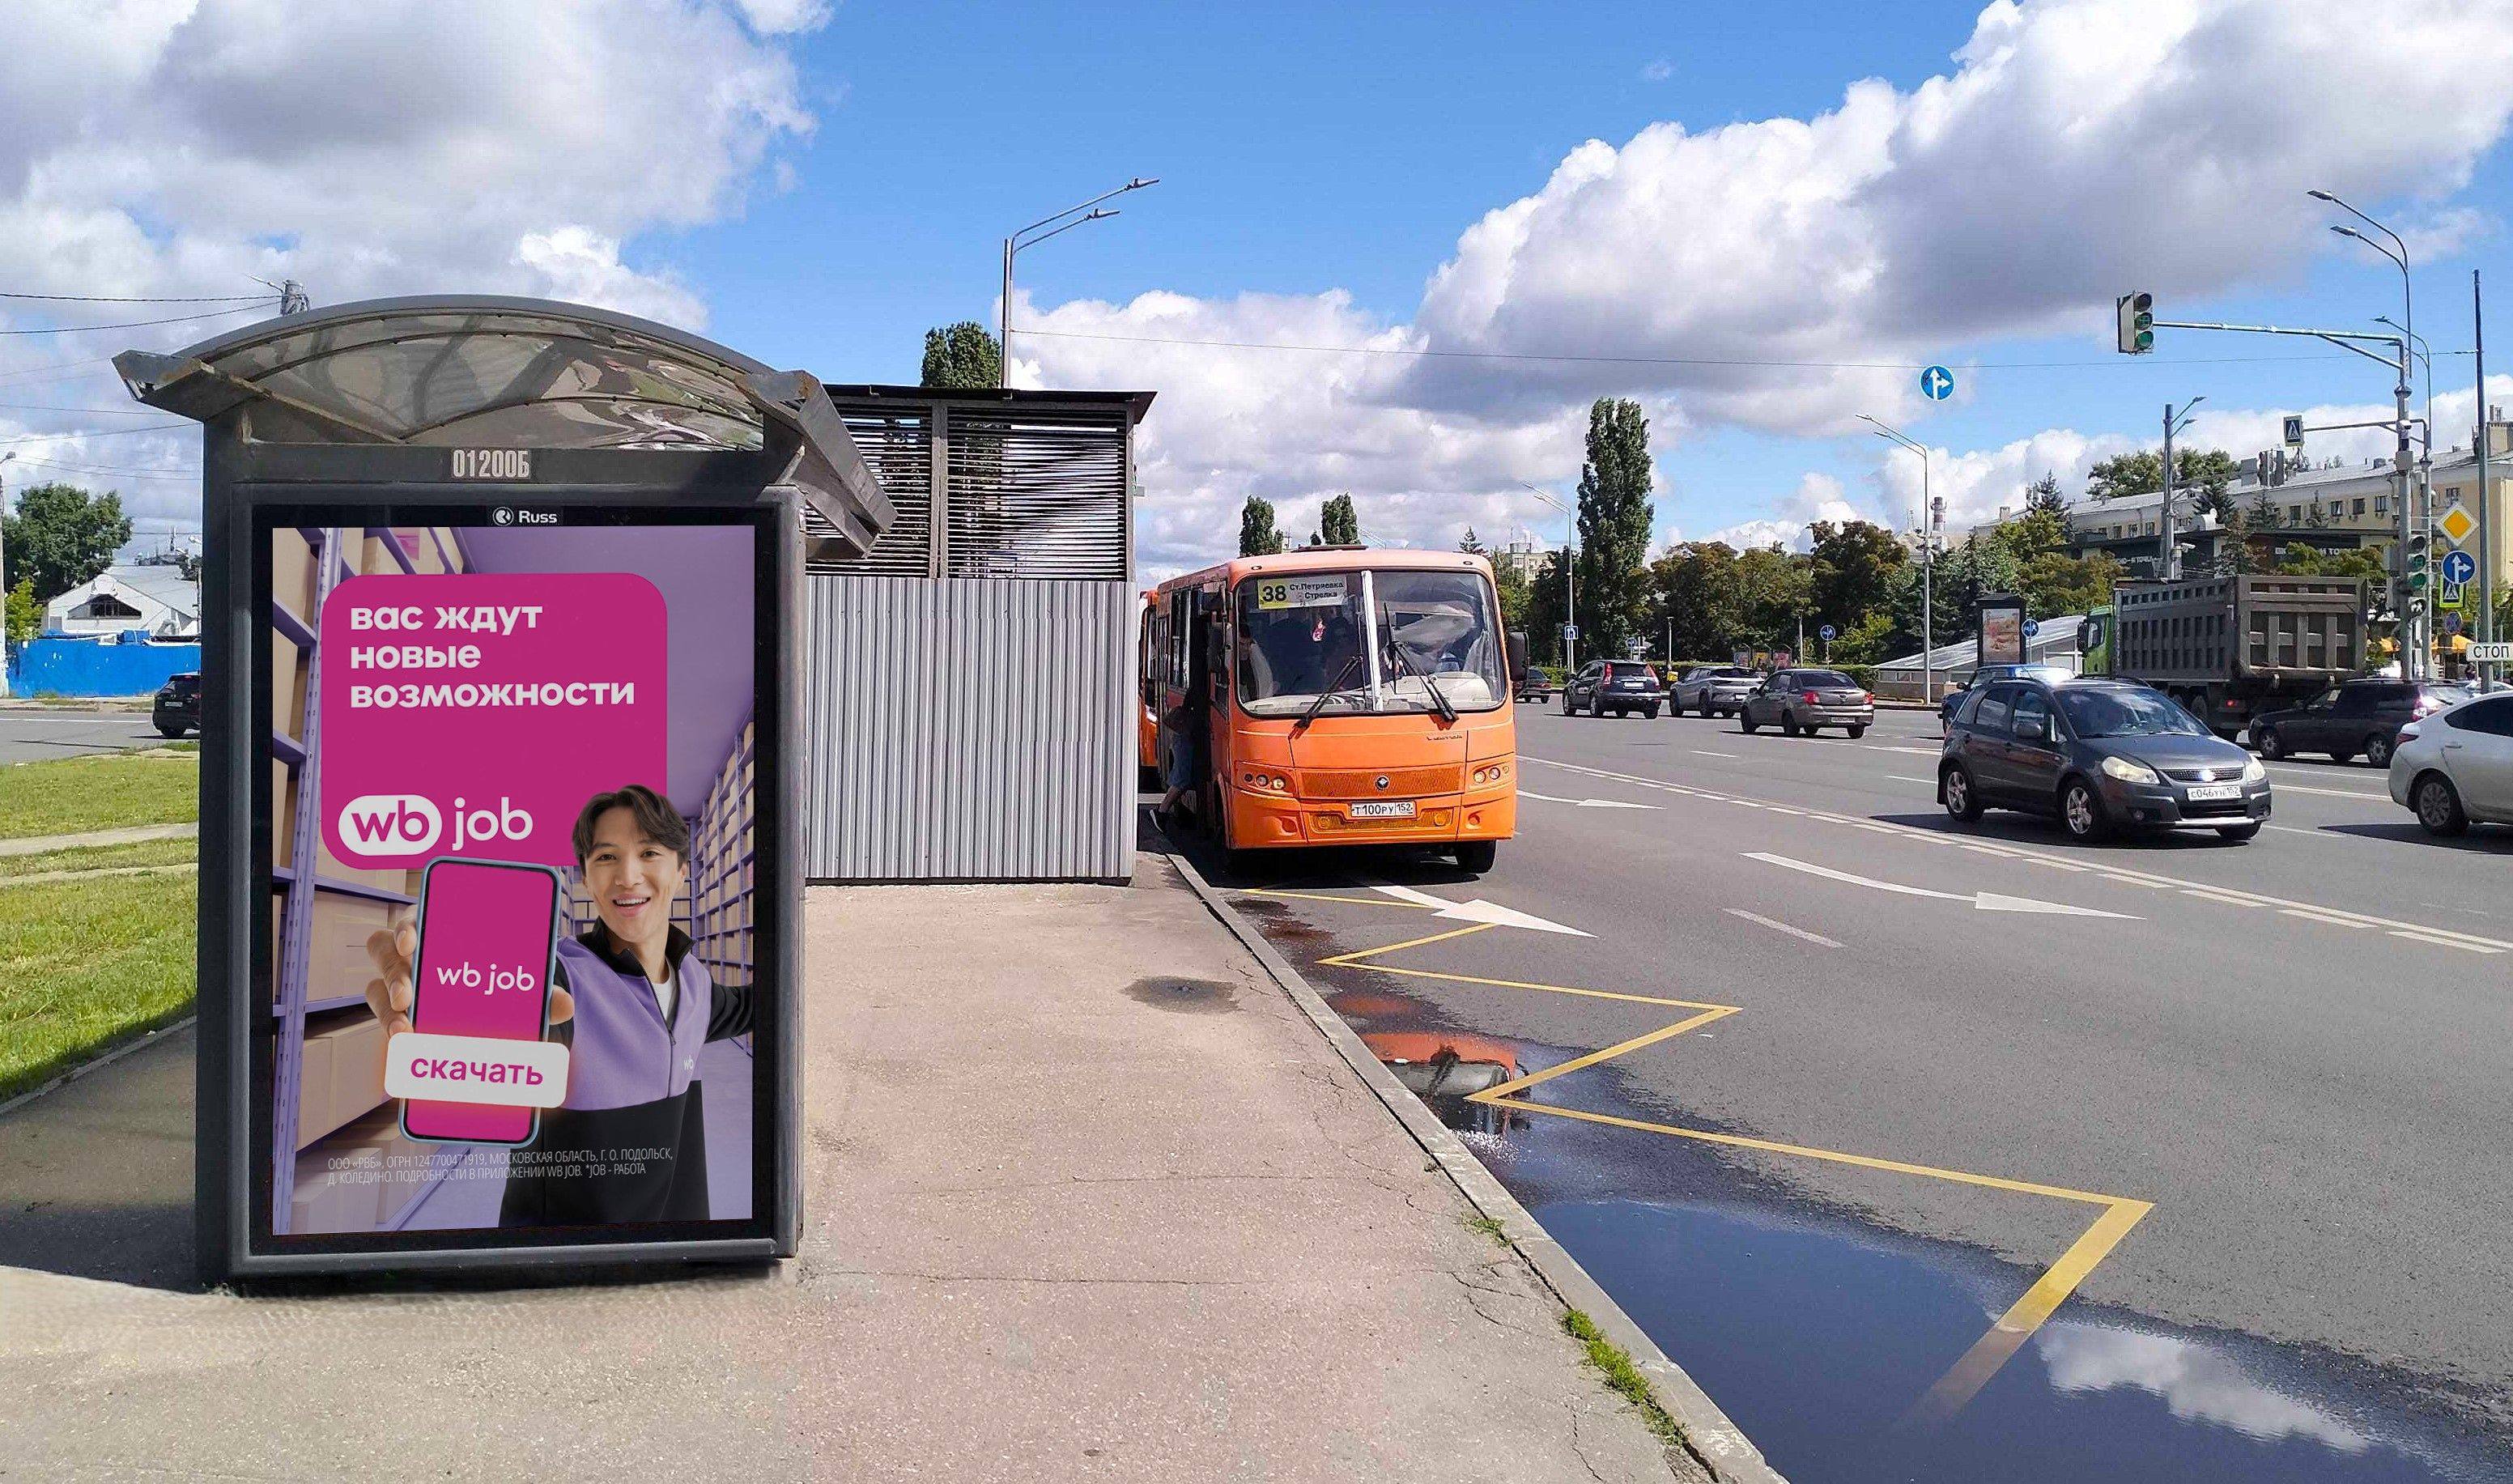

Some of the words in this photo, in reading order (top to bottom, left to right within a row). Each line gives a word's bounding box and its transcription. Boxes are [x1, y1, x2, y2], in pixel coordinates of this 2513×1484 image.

[453, 449, 529, 478] 01200Б
[518, 510, 558, 524] Russ
[1263, 585, 1286, 602] 38
[351, 606, 423, 631] вас
[434, 606, 542, 636] ждут
[351, 644, 481, 670] новые
[2473, 645, 2509, 658] СТОП
[351, 682, 635, 709] возможности
[351, 800, 430, 842] wb
[452, 797, 534, 852] job
[436, 962, 481, 988] wb
[484, 963, 535, 995] job
[410, 1058, 543, 1085] скачать
[328, 1158, 349, 1170] ООО
[387, 1155, 411, 1167] ОГРН
[490, 1151, 552, 1164] МОСКОВСКАЯ
[555, 1150, 598, 1163] ОБЛАСТЬ,
[621, 1147, 673, 1161] ПОДОЛЬСК,
[340, 1171, 393, 1185] КОЛЕДИНО.
[396, 1167, 467, 1183] ПОДРОБНОСТИ
[470, 1167, 475, 1180] В
[478, 1166, 545, 1180] ПРИЛОЖЕНИИ
[546, 1165, 563, 1177] WB
[614, 1163, 646, 1176] РАБОТА
